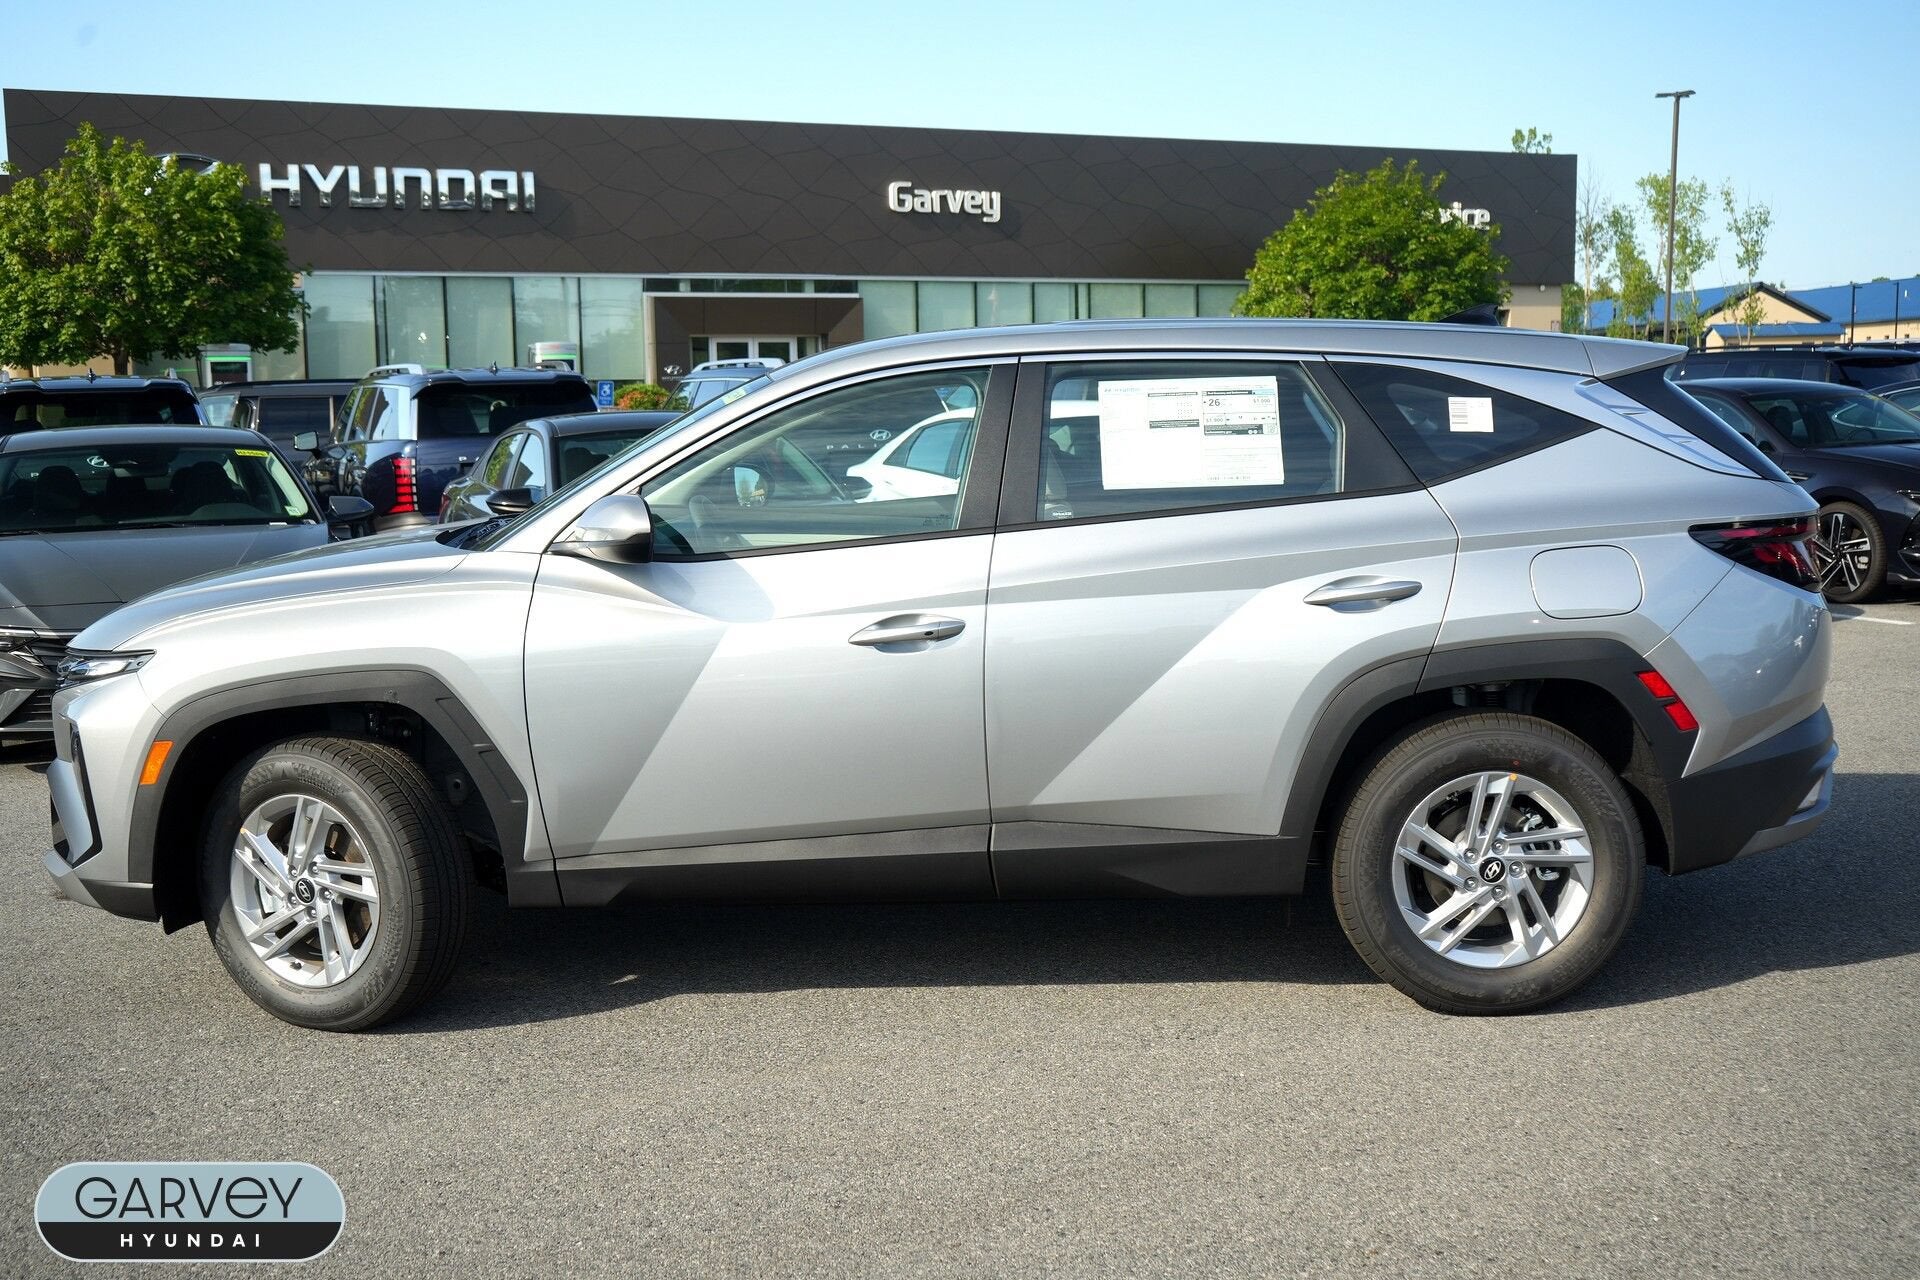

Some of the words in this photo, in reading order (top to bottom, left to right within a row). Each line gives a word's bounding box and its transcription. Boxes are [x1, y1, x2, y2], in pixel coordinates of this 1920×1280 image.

[259, 162, 535, 213] HYUNDAI
[888, 181, 1001, 223] Garvey
[1438, 201, 1491, 230] vice
[1208, 398, 1221, 407] 26
